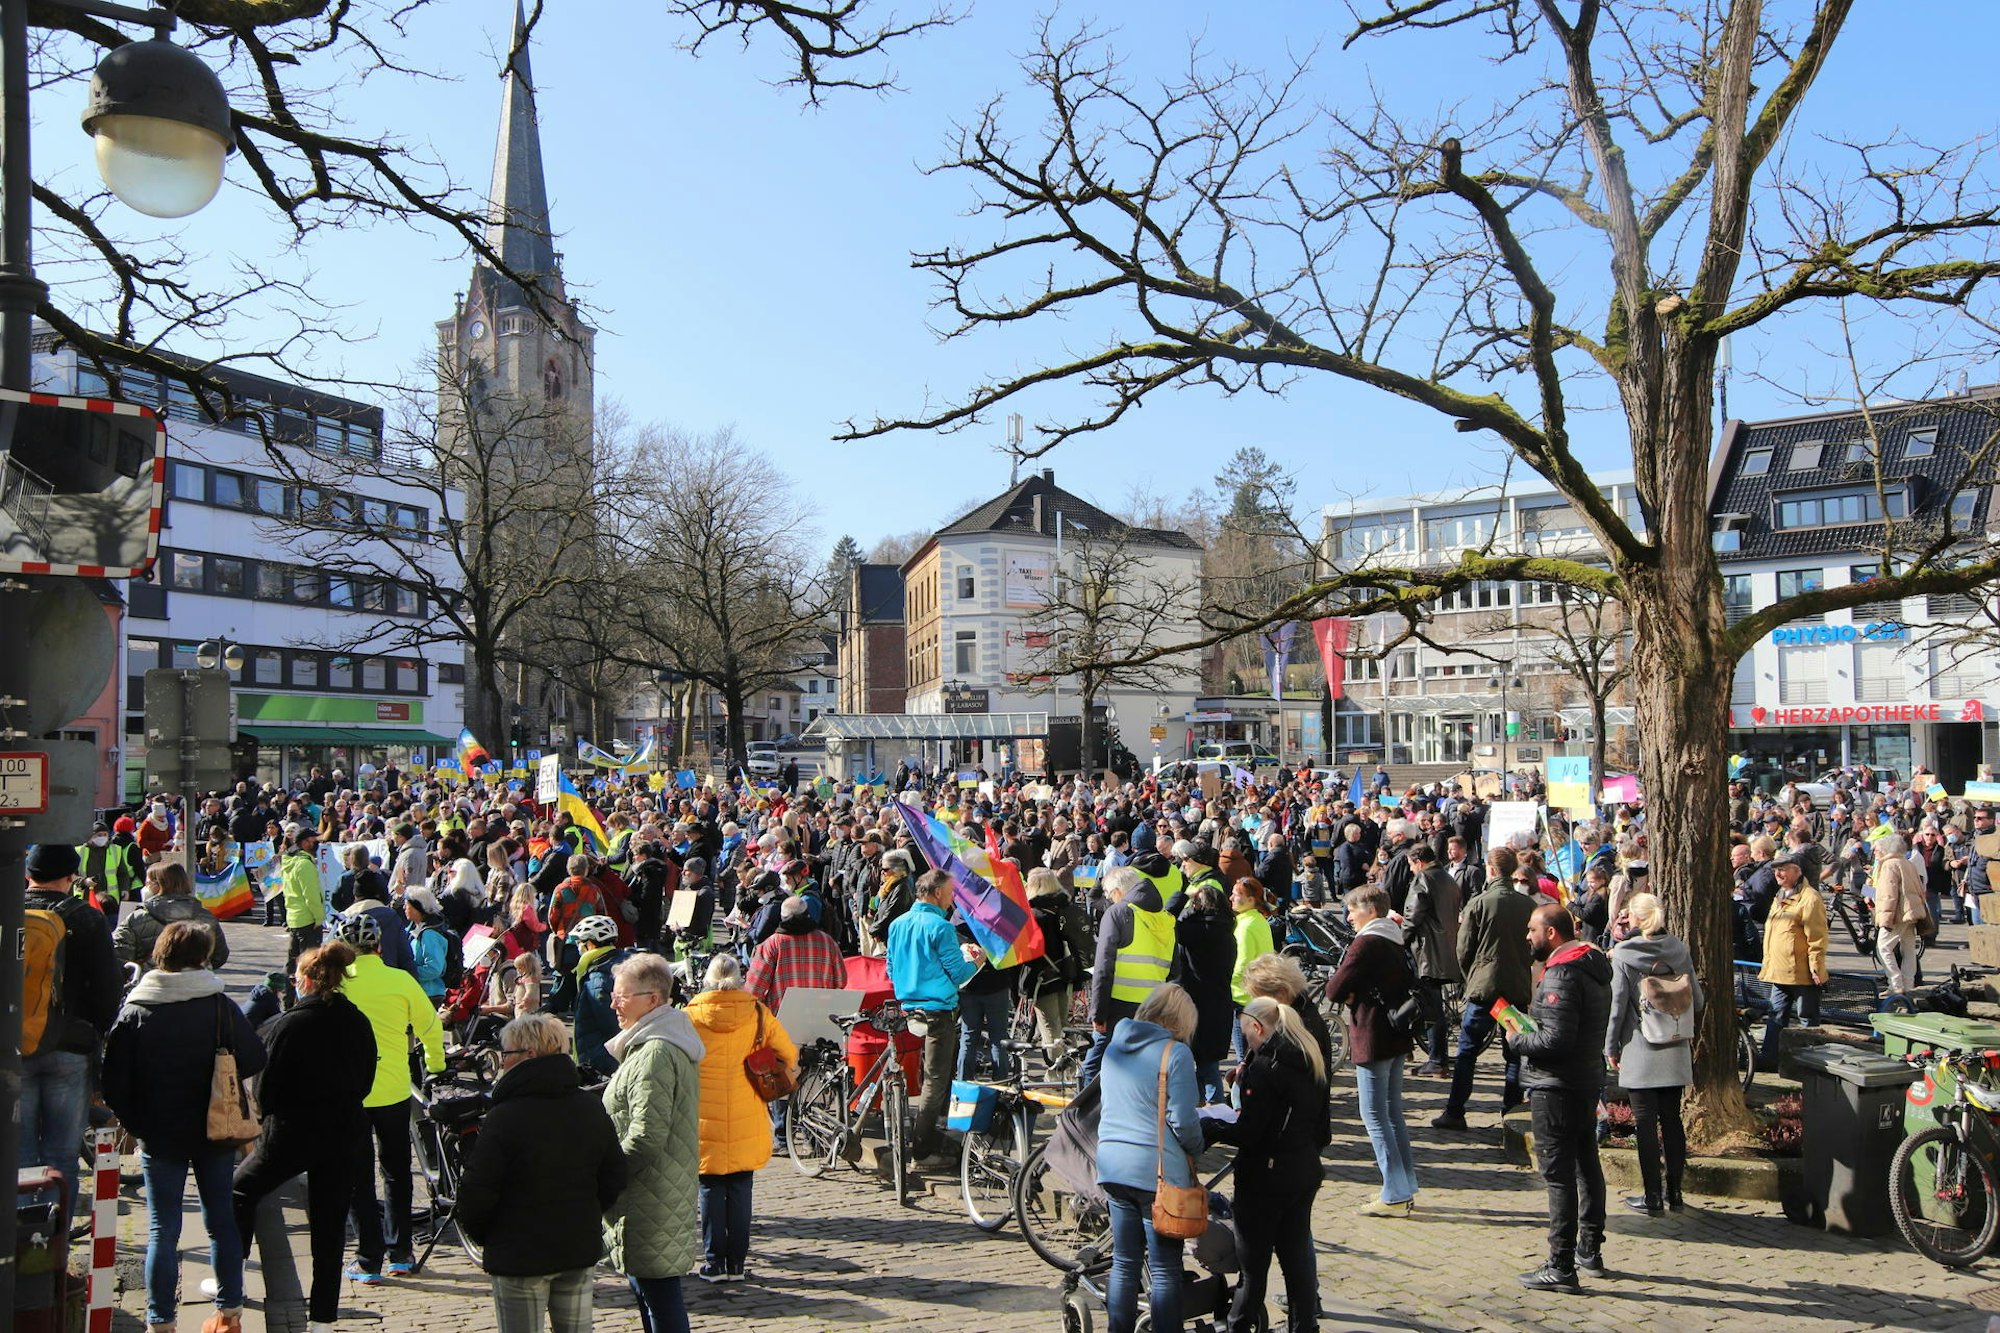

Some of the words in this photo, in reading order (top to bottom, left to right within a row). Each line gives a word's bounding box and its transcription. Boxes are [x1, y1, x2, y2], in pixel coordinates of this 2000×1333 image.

[1772, 624, 1857, 645] PHYSIO
[1774, 703, 1940, 725] HERZAPOTHEKE
[541, 763, 556, 778] FCK
[540, 779, 555, 795] PTN
